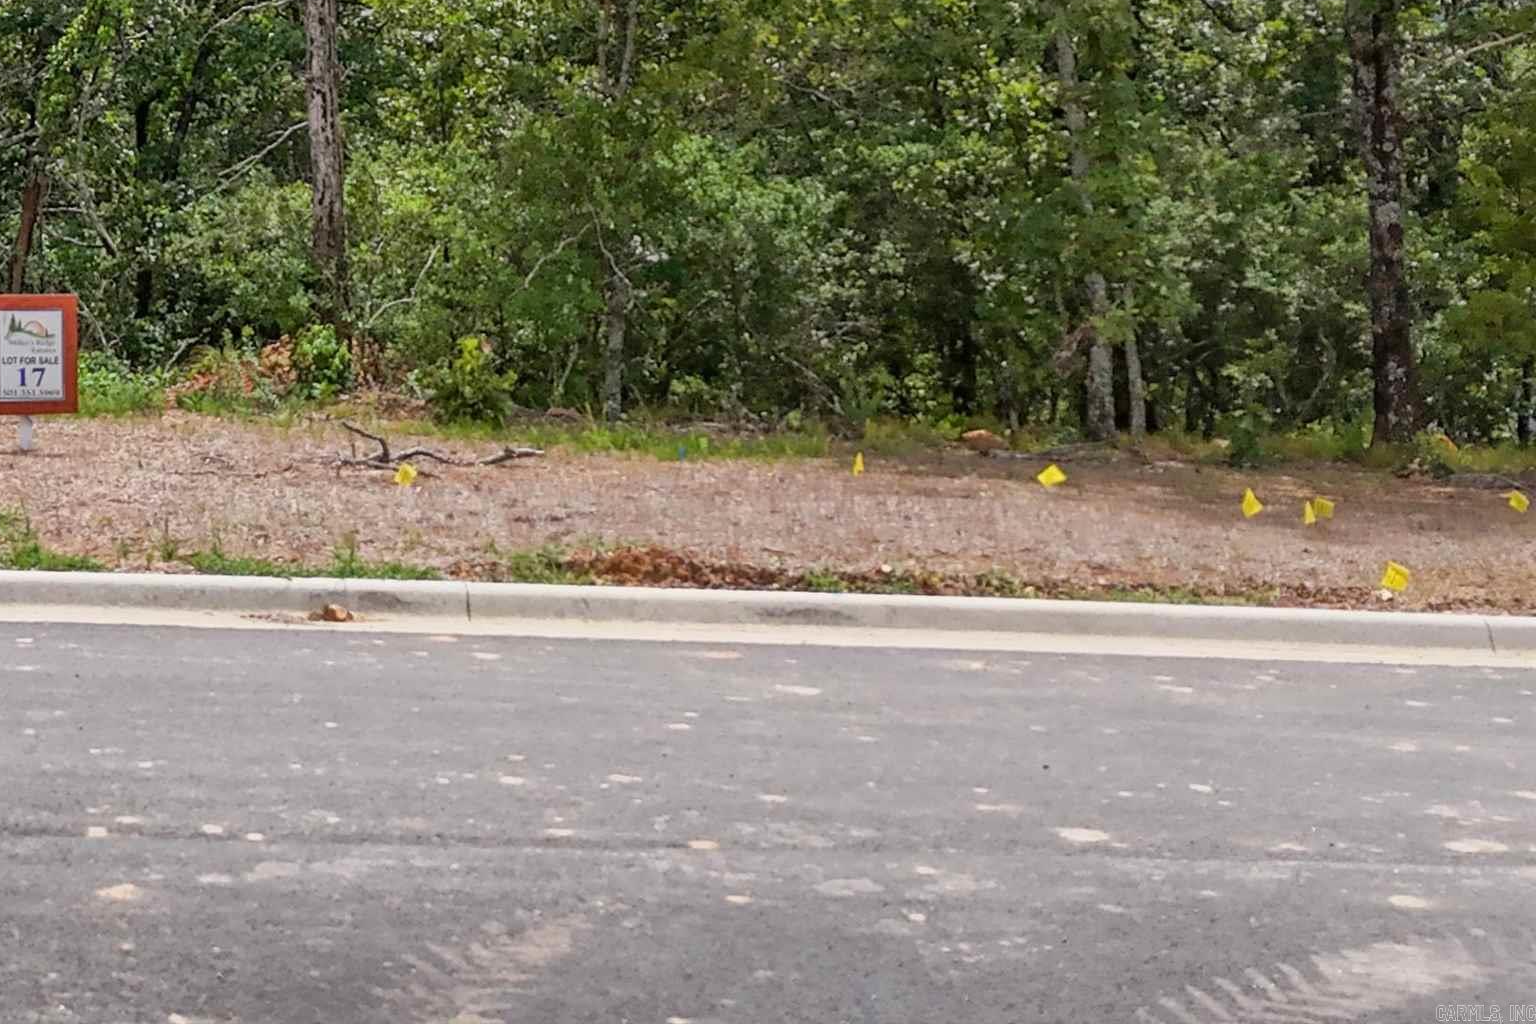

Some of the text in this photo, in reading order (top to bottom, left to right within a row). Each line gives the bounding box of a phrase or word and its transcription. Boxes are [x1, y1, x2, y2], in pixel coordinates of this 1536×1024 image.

[1, 355, 59, 365] LOT FOR SALE
[17, 367, 46, 387] 17
